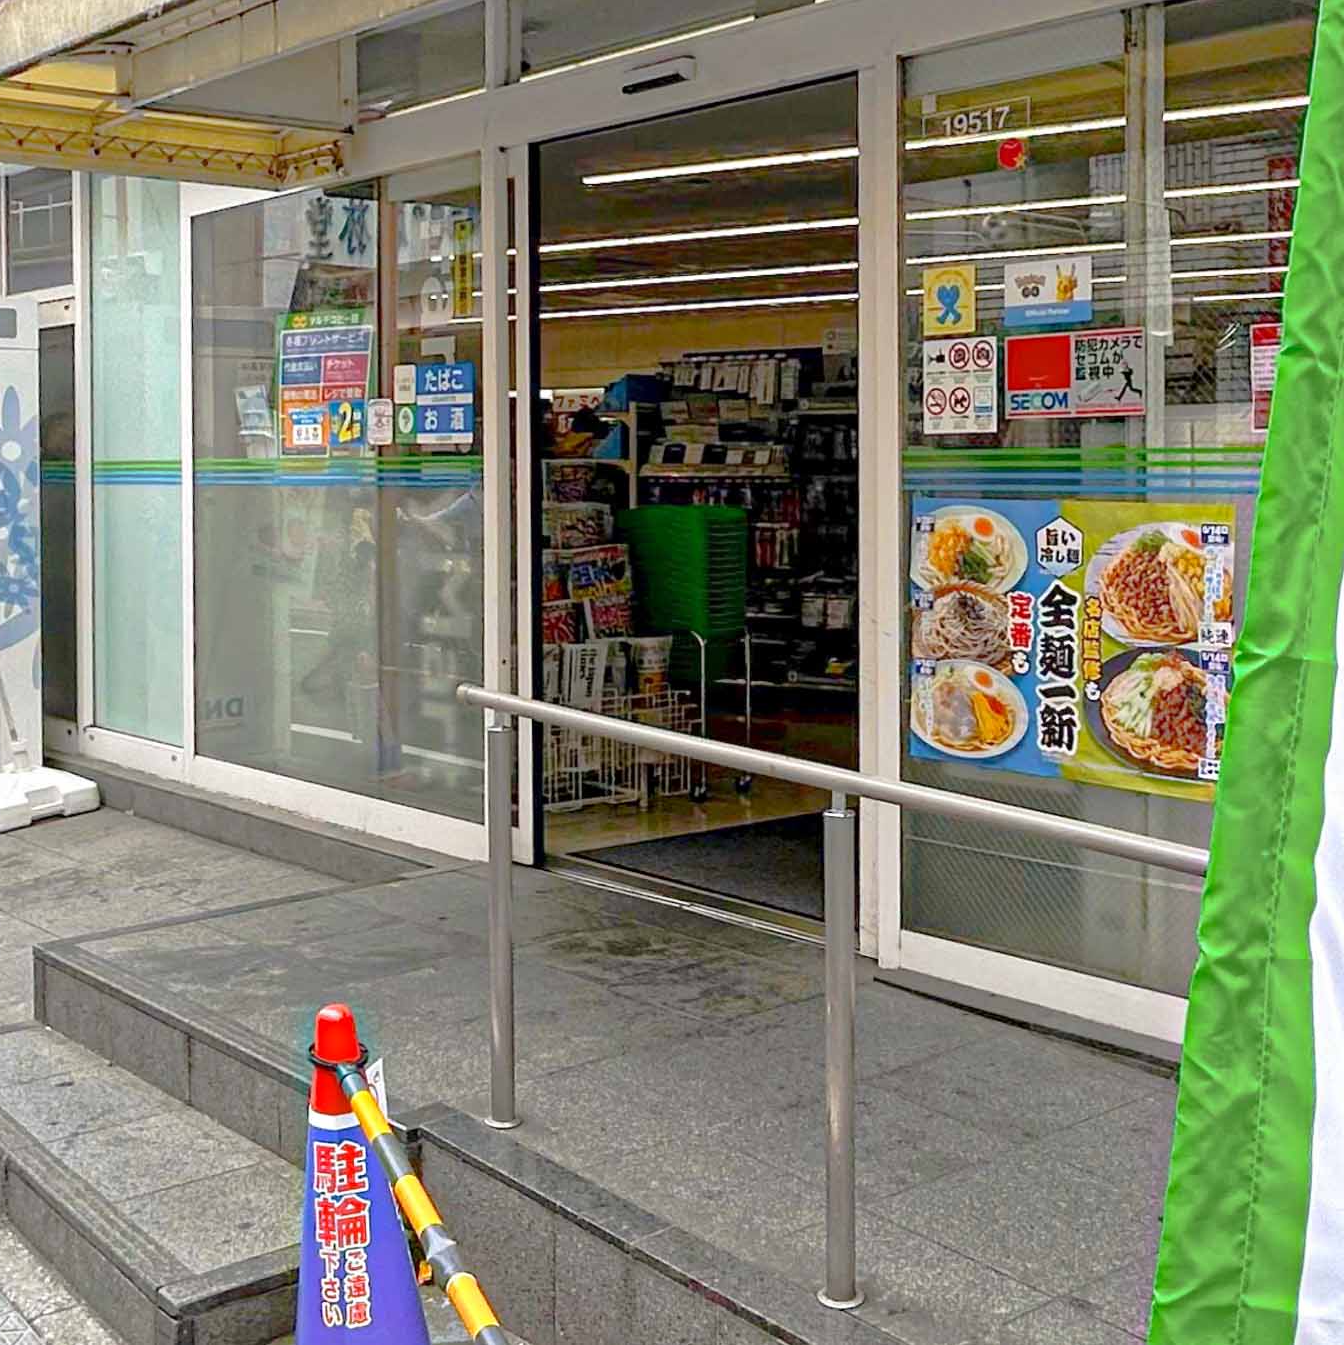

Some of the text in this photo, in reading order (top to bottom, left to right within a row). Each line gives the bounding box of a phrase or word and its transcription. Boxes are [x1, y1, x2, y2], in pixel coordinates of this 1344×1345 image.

[942, 105, 1010, 136] 19517
[1074, 335, 1143, 352] 防犯カメラで
[1074, 350, 1124, 366] セコムが
[424, 367, 465, 392] たばこ
[1074, 366, 1115, 381] 監視中
[1010, 391, 1069, 411] SECOM
[1045, 528, 1077, 547] 旨い
[1008, 592, 1034, 675] 定番も
[313, 1139, 372, 1252] 駐輪
[319, 1249, 343, 1328] 下さい
[344, 1249, 373, 1329] ご遠慮
